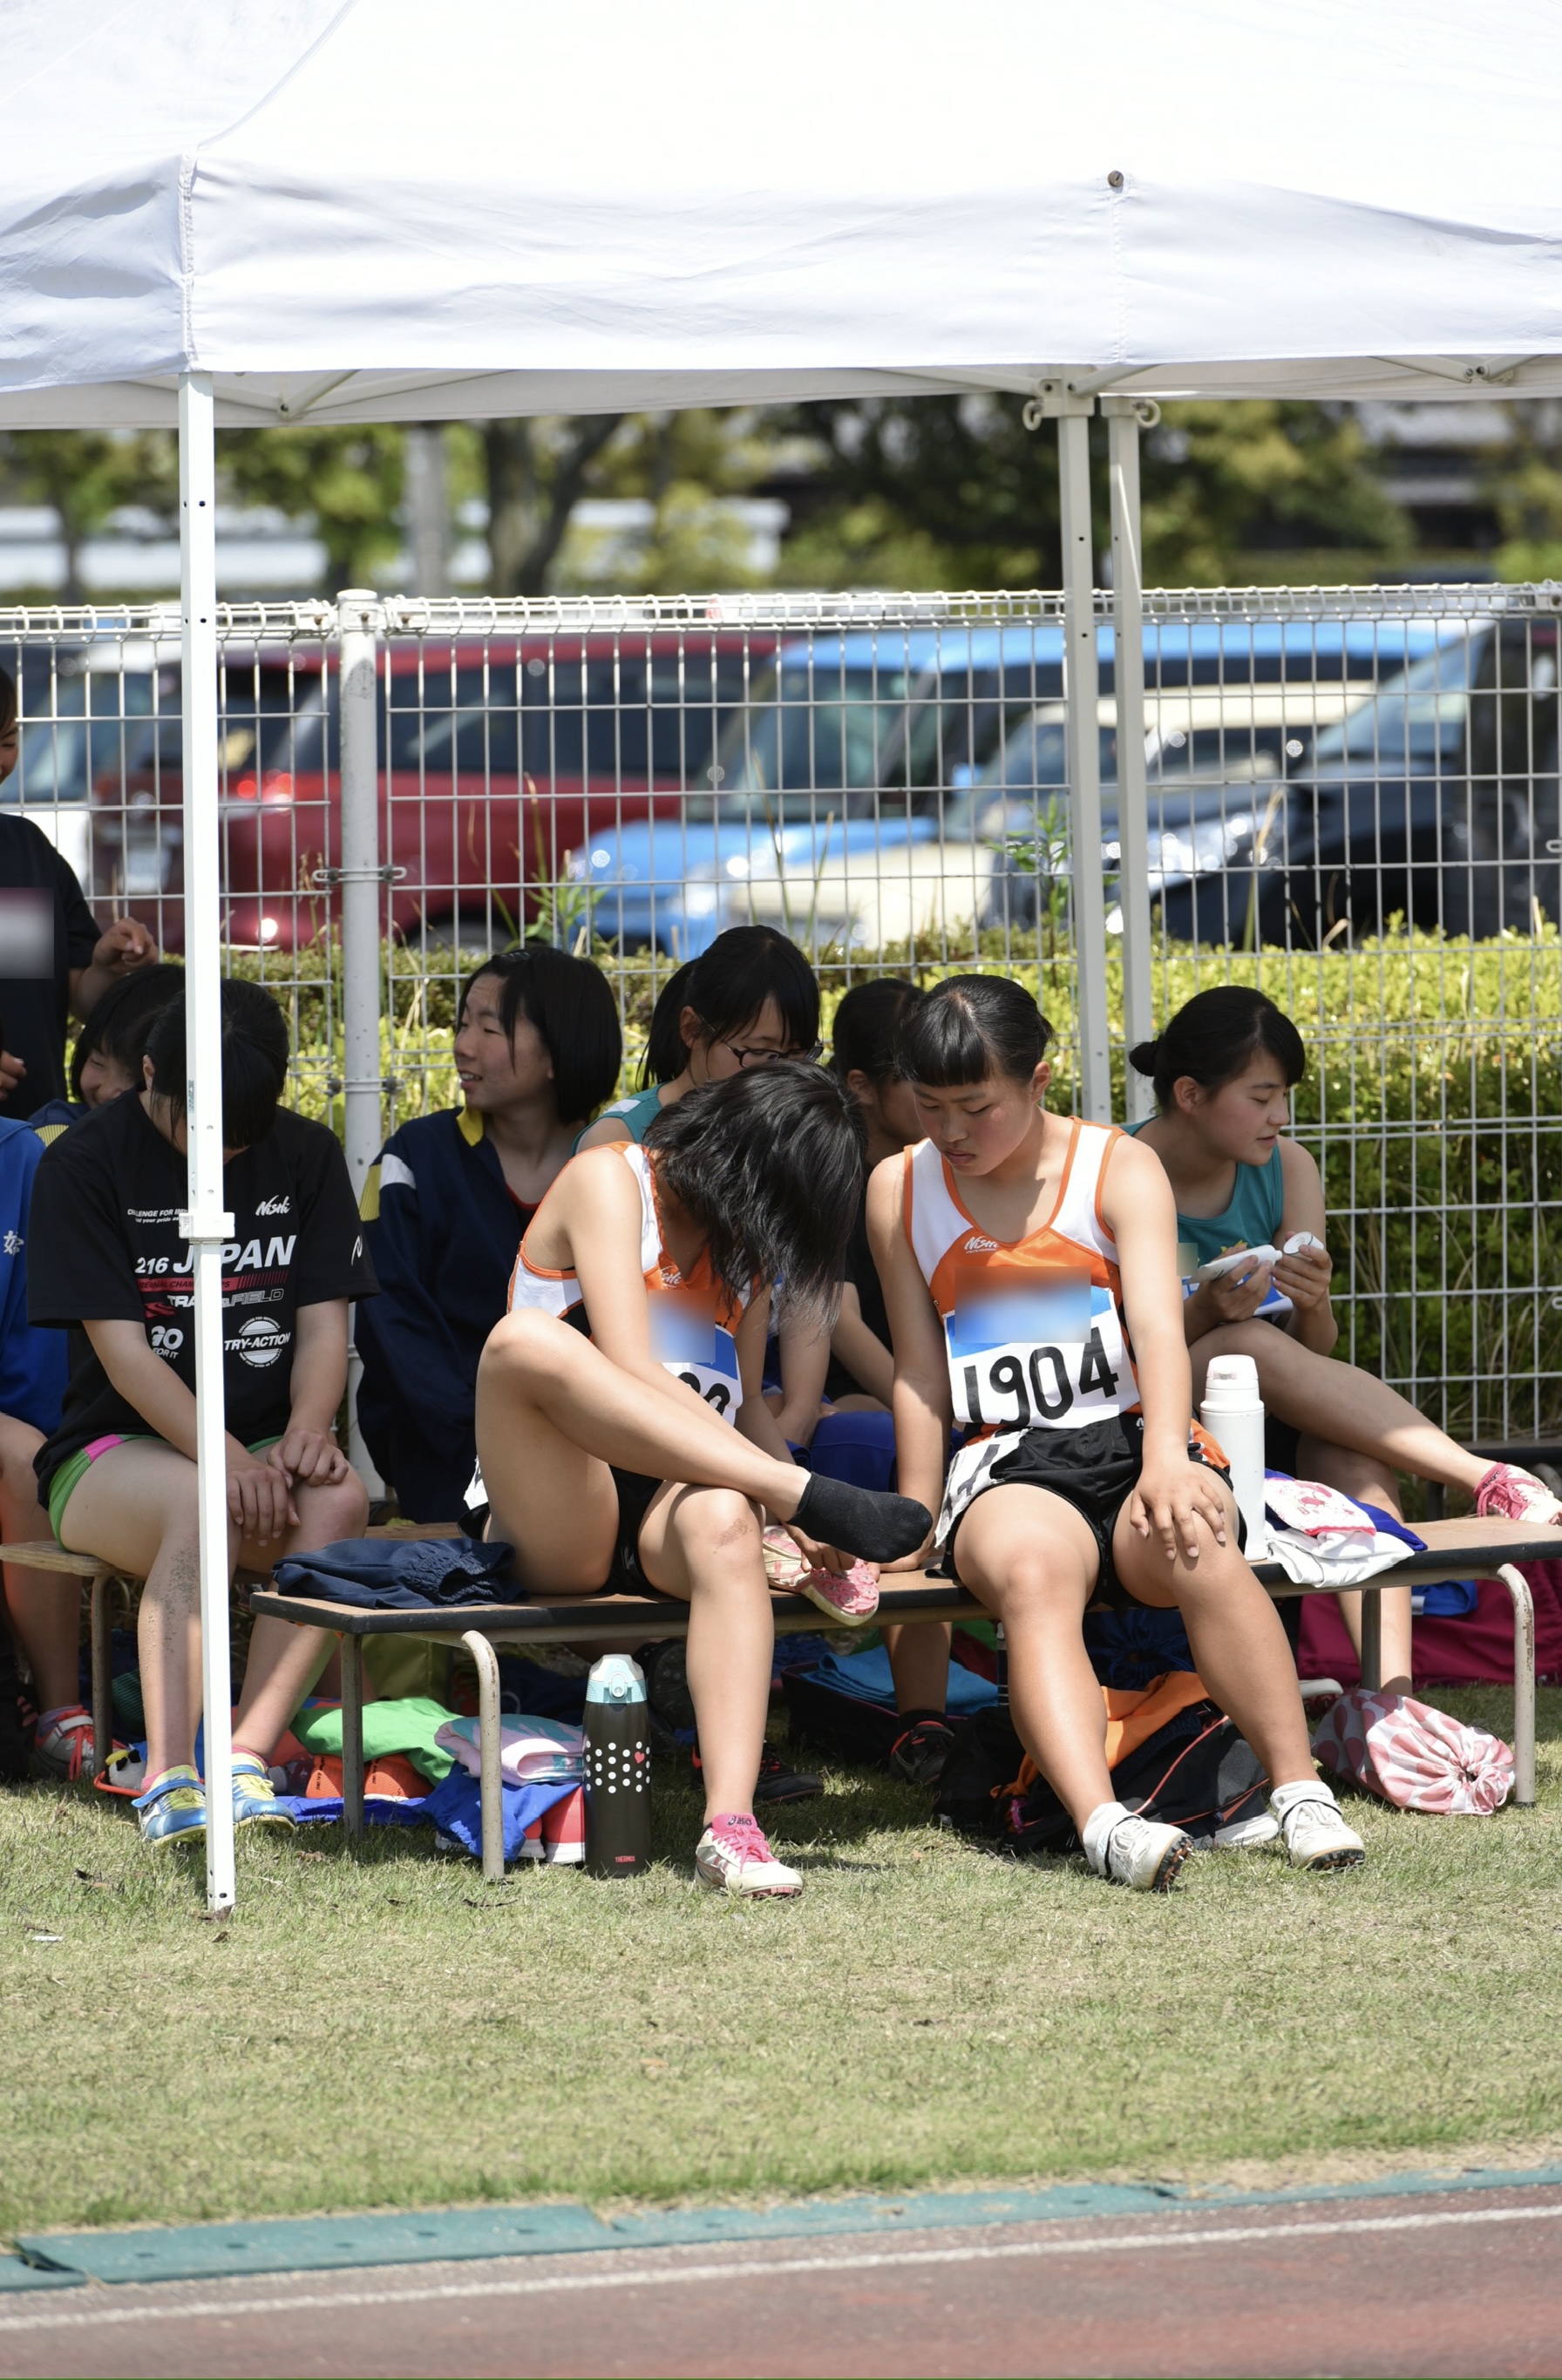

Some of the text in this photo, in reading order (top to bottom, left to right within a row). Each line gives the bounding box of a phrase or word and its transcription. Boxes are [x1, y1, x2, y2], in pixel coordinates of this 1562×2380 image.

[173, 1234, 297, 1274] JPAN
[224, 1332, 291, 1351] TRY-ACTION
[963, 1326, 1119, 1426] 1904
[737, 1817, 752, 1826] asics
